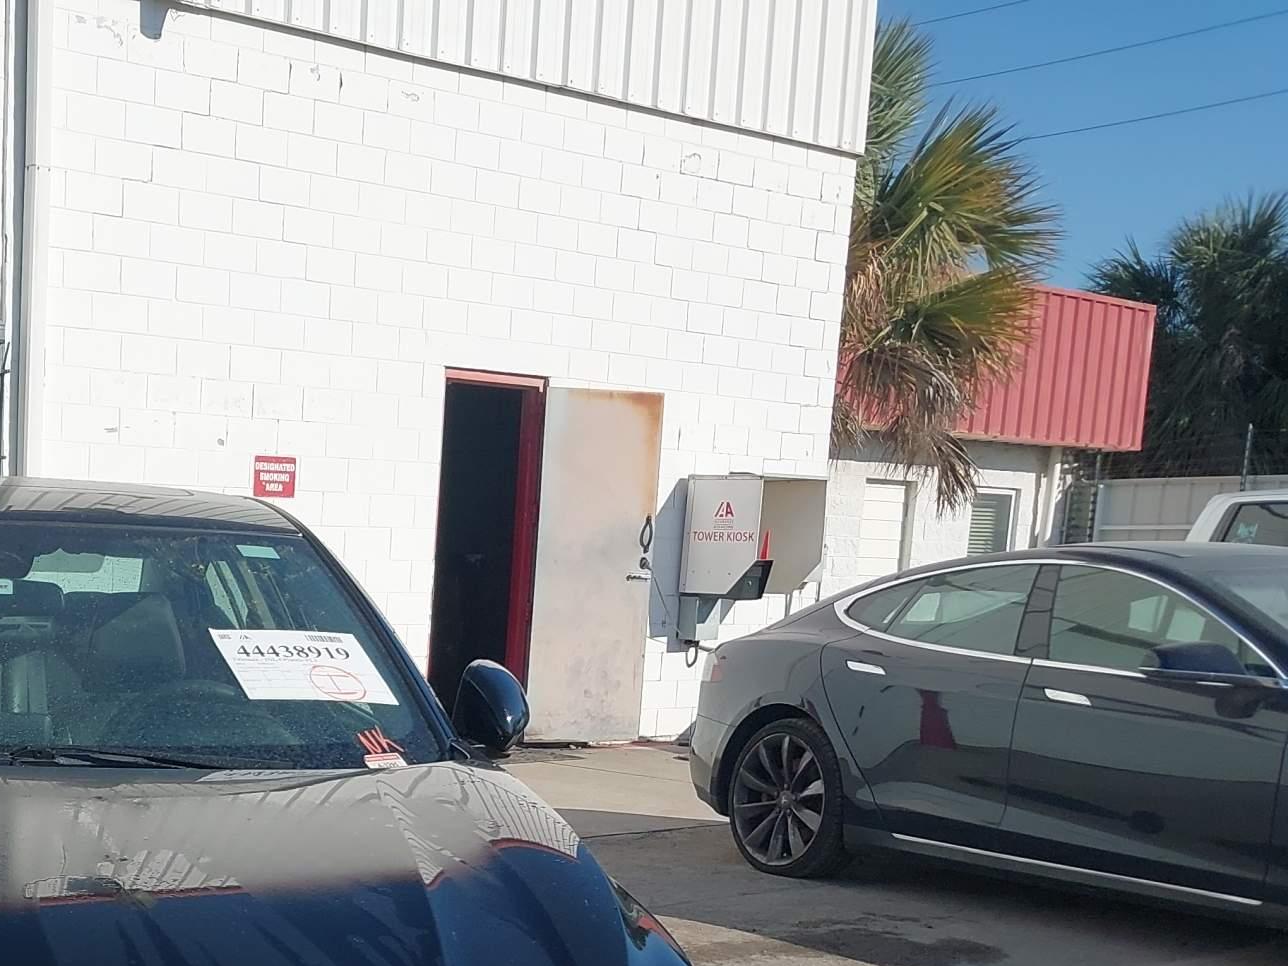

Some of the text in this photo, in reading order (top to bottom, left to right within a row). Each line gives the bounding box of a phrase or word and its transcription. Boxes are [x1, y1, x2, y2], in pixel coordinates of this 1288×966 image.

[255, 461, 295, 472] DESIGNATED
[259, 472, 289, 482] SMOKING
[265, 482, 283, 491] AREA
[693, 531, 754, 542] TOWER KIOSK
[237, 644, 350, 661] 44438919
